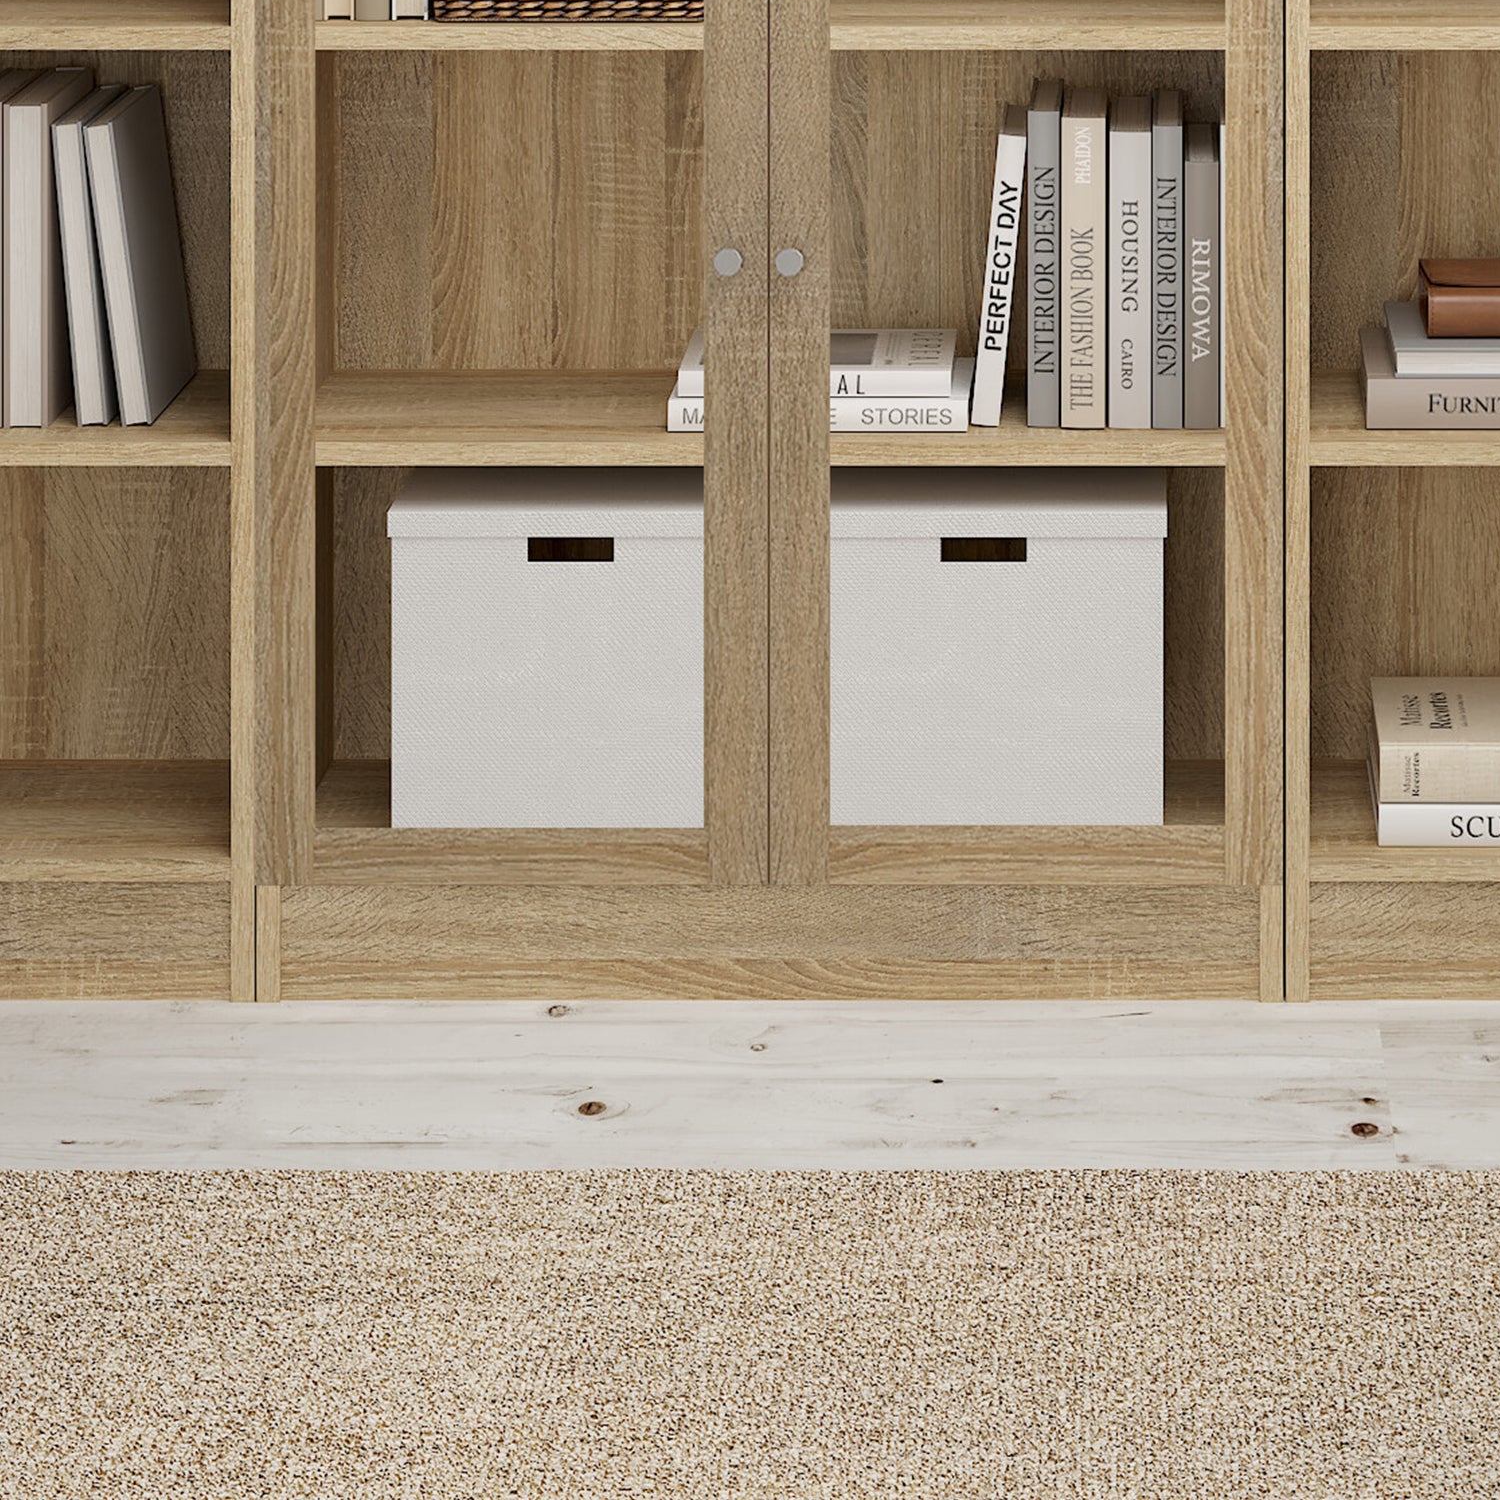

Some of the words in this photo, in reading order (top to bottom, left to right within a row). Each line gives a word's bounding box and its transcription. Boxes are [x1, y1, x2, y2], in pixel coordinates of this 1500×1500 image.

[1074, 125, 1092, 186] PHAIDON
[996, 181, 1019, 229] DAY
[1033, 166, 1056, 256] DESIGN
[1156, 177, 1178, 286] INTERIOR
[1070, 227, 1094, 282] BOOK
[1121, 200, 1139, 314] HOUSING
[984, 235, 1012, 352] PERFECT
[1033, 262, 1056, 376] INTERIOR
[1070, 284, 1094, 367] FASHION
[1191, 238, 1212, 362] RIMOWA
[1120, 339, 1134, 390] CAIRO
[1156, 291, 1178, 378] DESIGN
[860, 408, 953, 426] STORIES
[1070, 371, 1094, 411] THE
[1429, 691, 1453, 730] Recortes
[1411, 751, 1420, 798] Recortes
